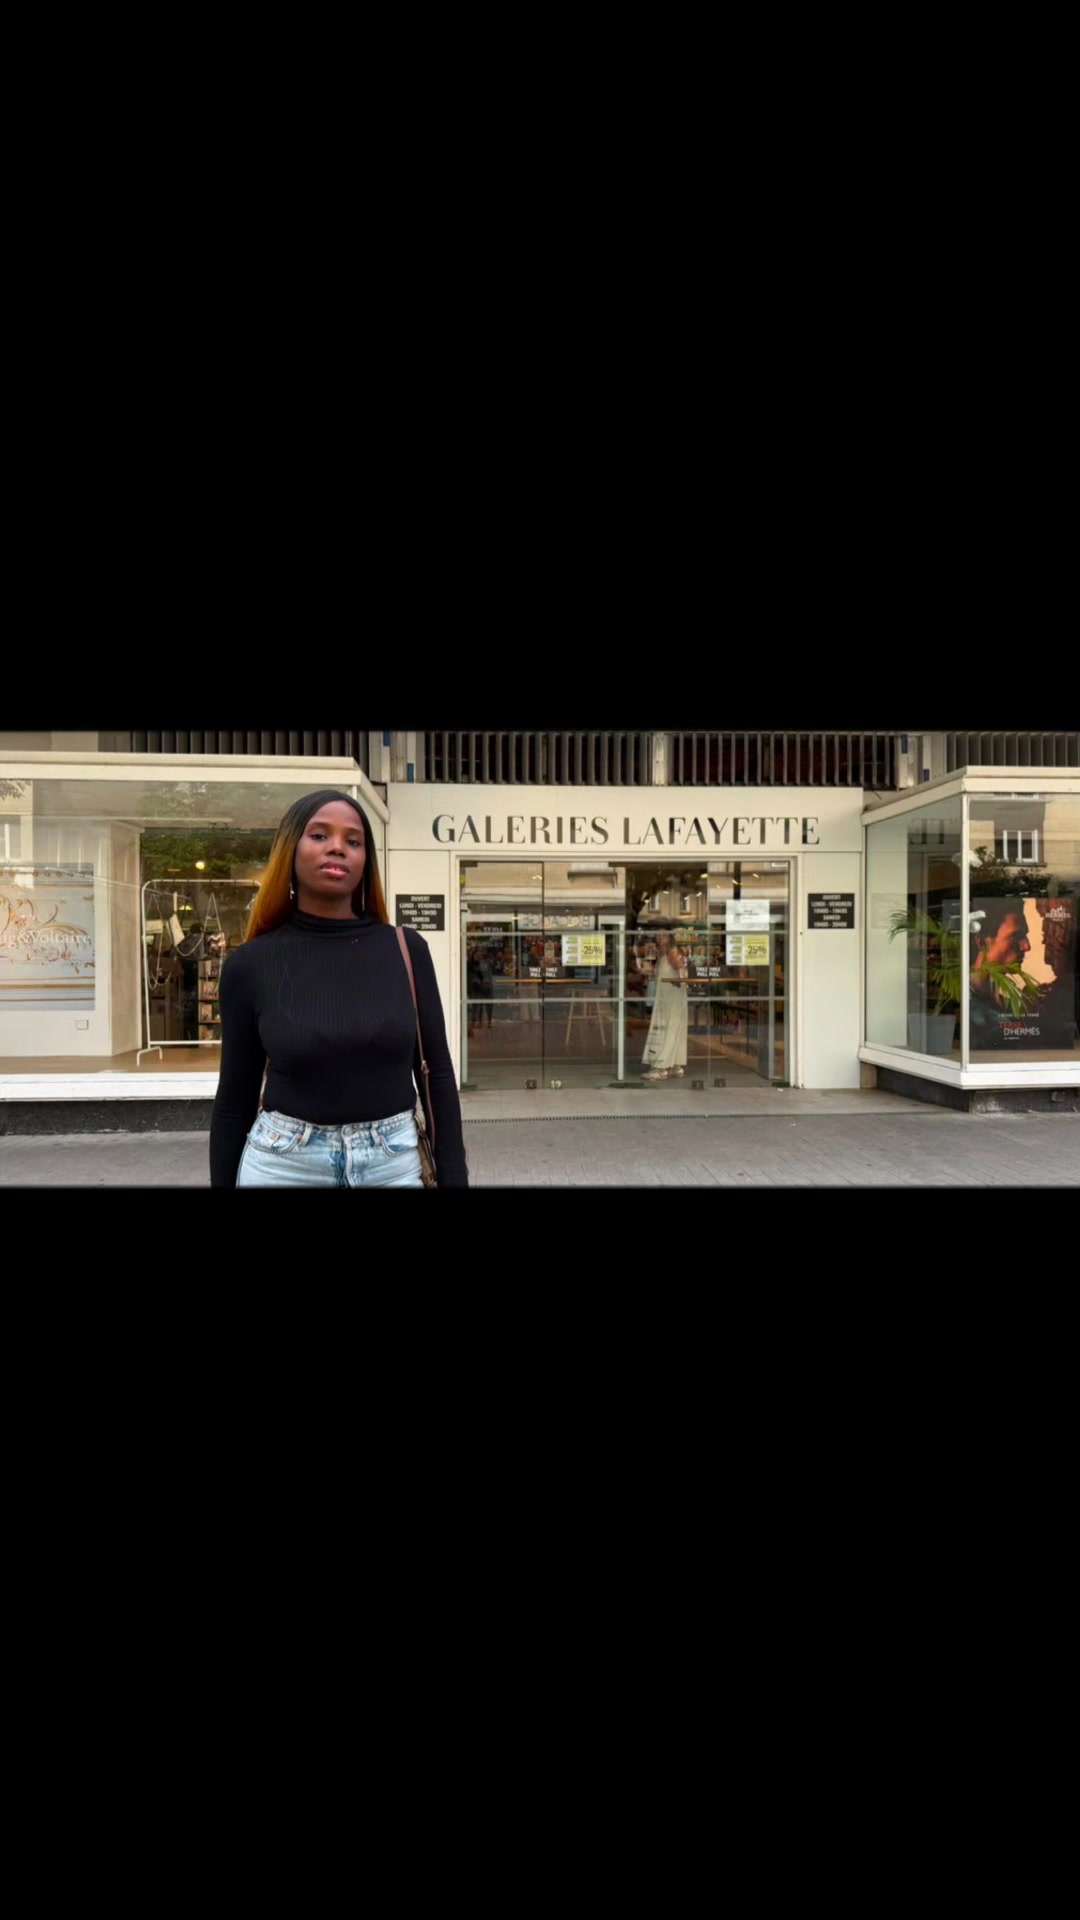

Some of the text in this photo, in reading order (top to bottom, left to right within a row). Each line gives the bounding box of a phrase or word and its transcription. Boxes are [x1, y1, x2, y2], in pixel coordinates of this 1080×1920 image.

[432, 814, 820, 845] GALERIES LAFAYETTE
[0, 929, 91, 949] ig&Voltaire
